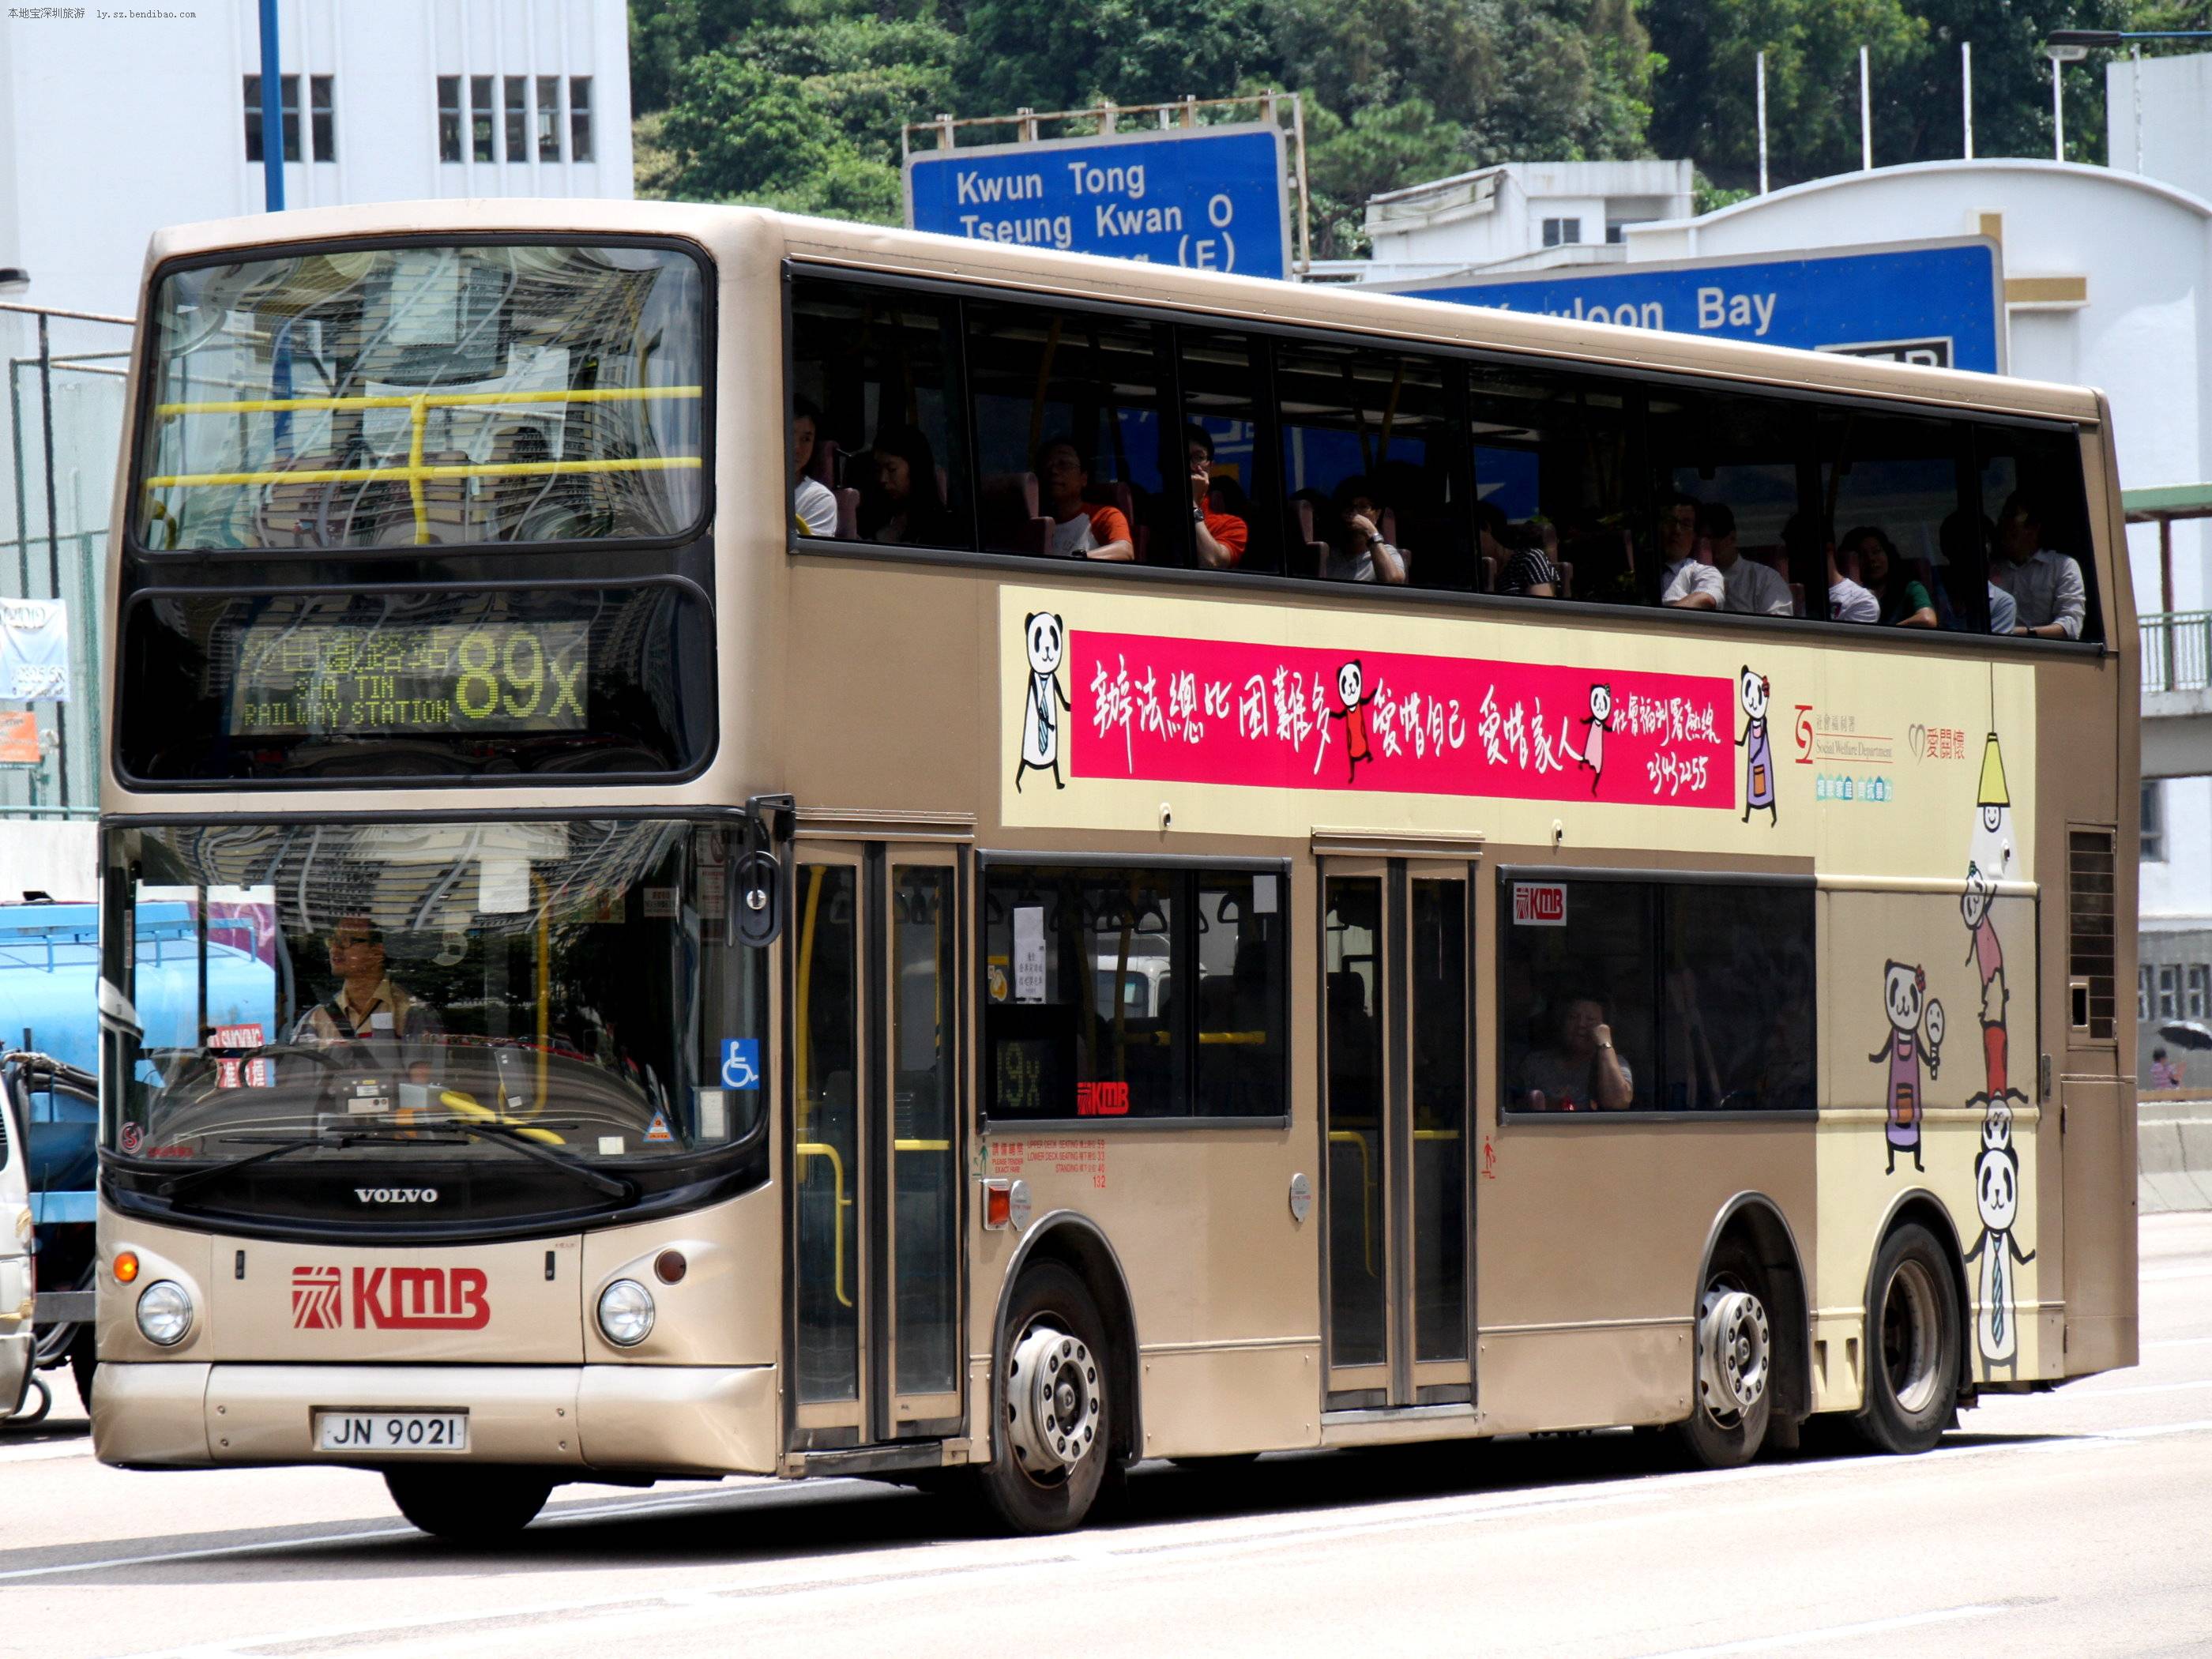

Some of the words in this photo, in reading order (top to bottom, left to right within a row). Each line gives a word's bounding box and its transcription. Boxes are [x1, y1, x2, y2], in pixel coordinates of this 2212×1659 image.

[957, 171, 1043, 205] Kwun
[1068, 161, 1146, 199] Tong
[1097, 203, 1183, 237] Kwan
[1208, 194, 1233, 228] O
[1698, 286, 1778, 337] Bay
[297, 676, 337, 700] SHA
[353, 675, 394, 699] TIN
[243, 702, 342, 728] RAILWAY
[351, 700, 450, 726] STATION
[1816, 739, 1834, 754] Social
[1834, 739, 1858, 756] Welfare
[1858, 741, 1893, 758] Department
[1646, 750, 1709, 797] 23432255
[1529, 887, 1563, 920] KMB
[1093, 1082, 1129, 1115] KMB
[355, 1188, 438, 1203] VOLVO
[1093, 1175, 1106, 1188] 132
[352, 1266, 491, 1330] KMB
[333, 1419, 372, 1445] JN
[386, 1419, 454, 1445] 9021
